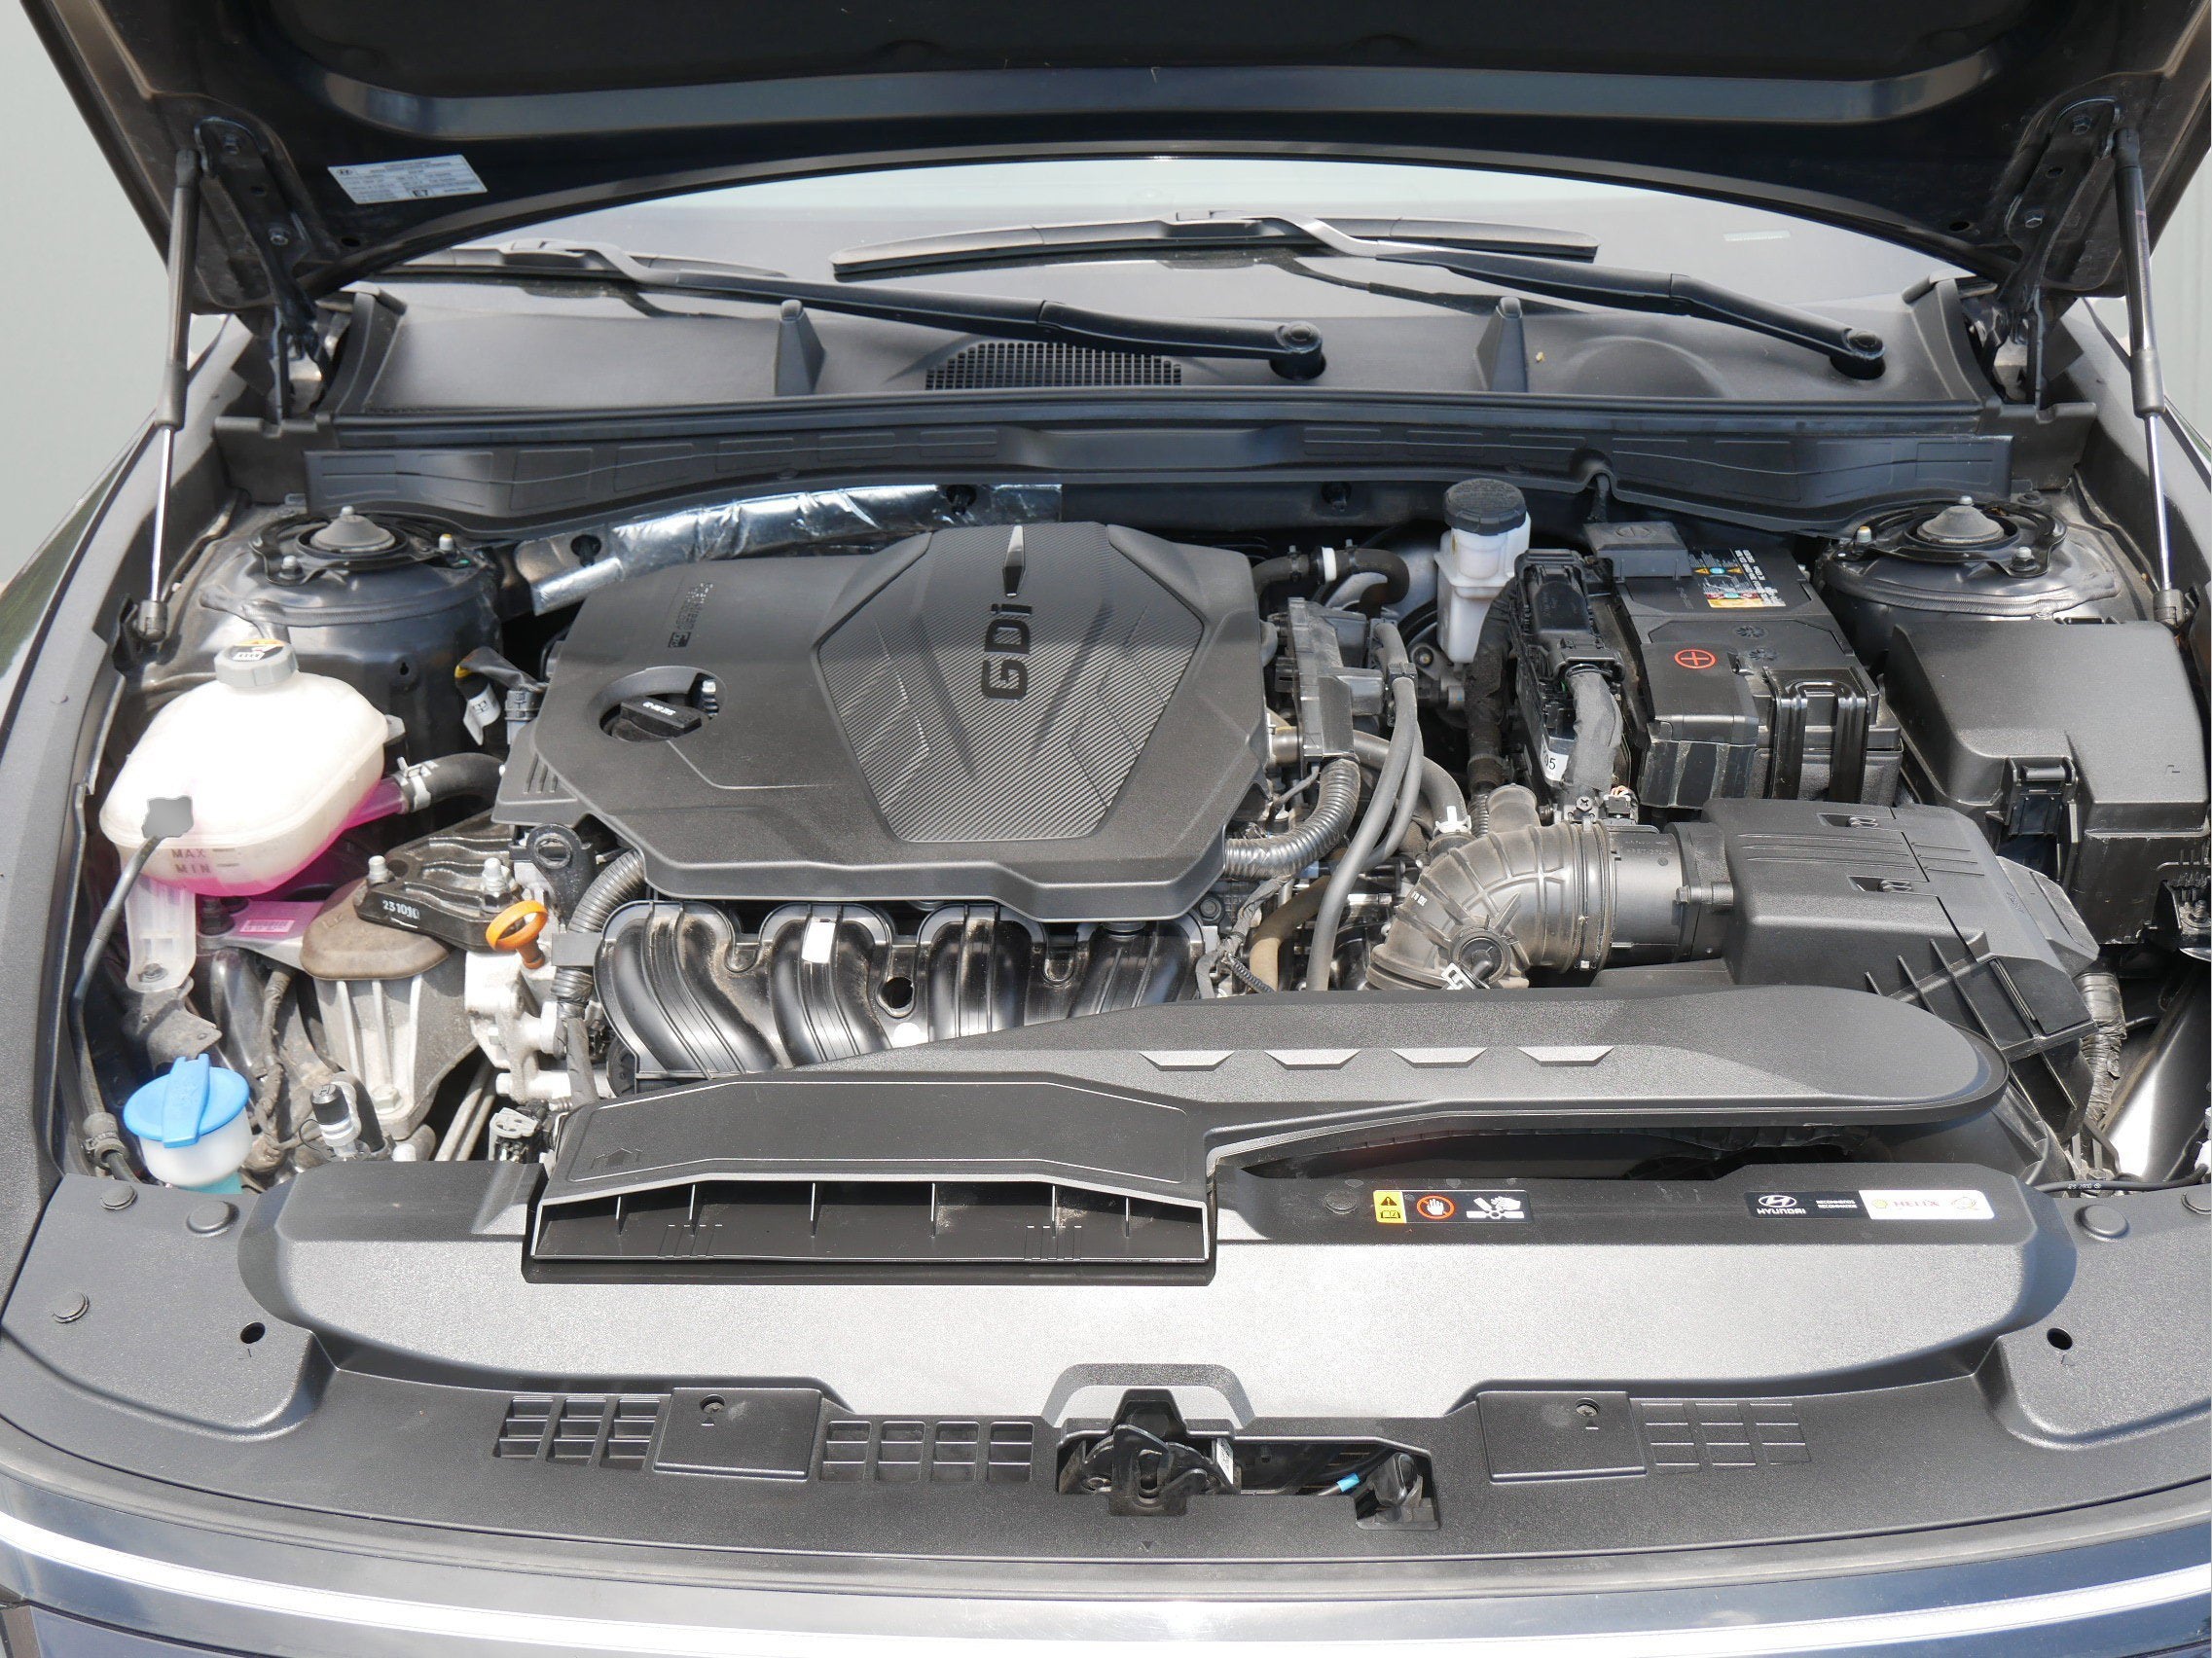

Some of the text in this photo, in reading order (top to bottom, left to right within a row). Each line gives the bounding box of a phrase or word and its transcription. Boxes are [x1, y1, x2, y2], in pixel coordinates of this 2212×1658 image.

[981, 603, 1033, 702] GDi
[171, 848, 206, 858] MAX
[175, 864, 211, 874] MIN
